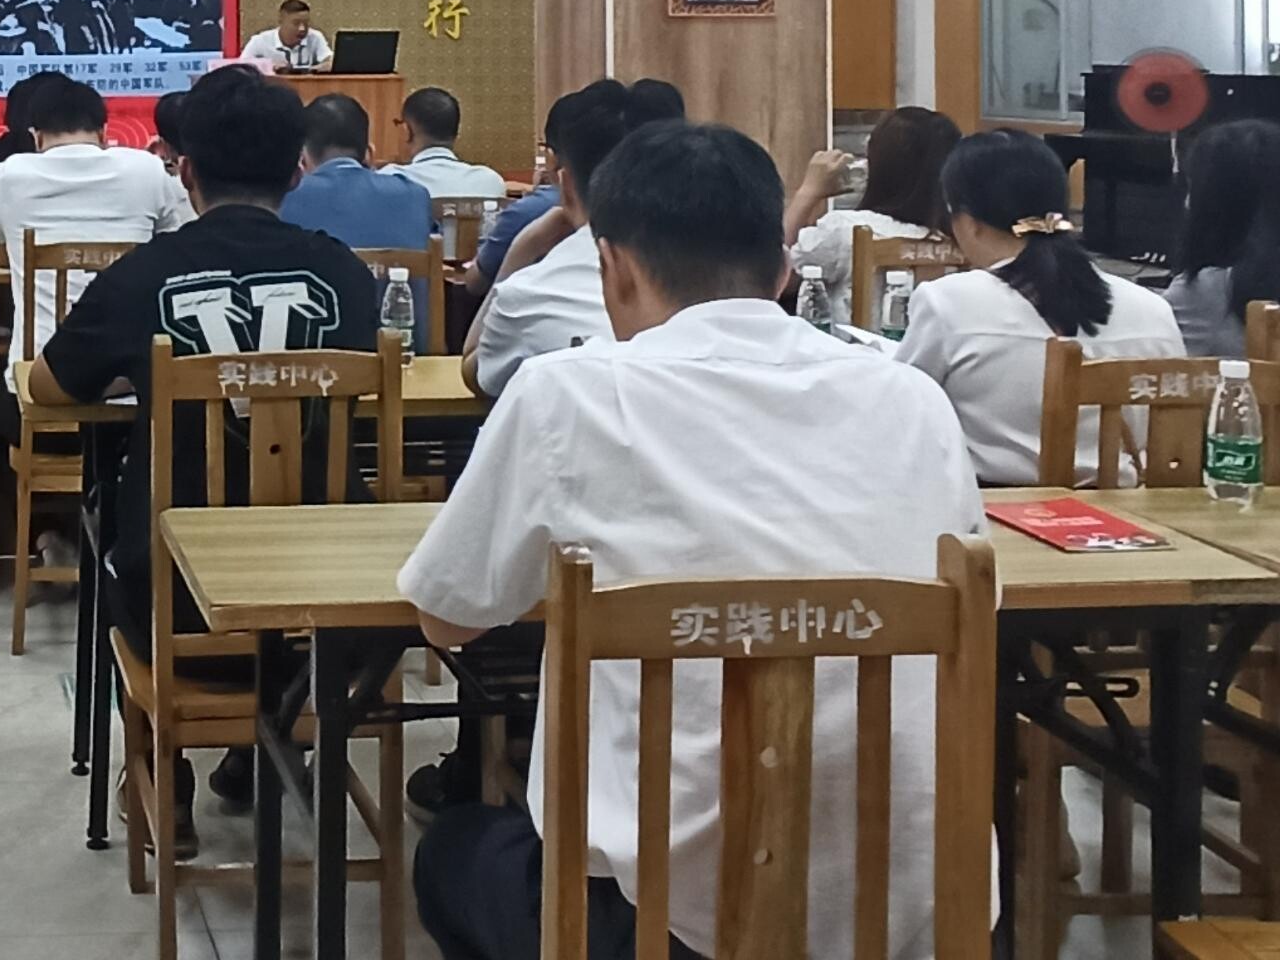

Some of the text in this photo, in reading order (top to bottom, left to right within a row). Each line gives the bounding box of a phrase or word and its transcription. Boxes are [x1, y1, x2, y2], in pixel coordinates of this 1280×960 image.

[217, 360, 339, 397] 实践中心
[1128, 371, 1220, 400] 实践中
[670, 598, 884, 656] 实践中心
